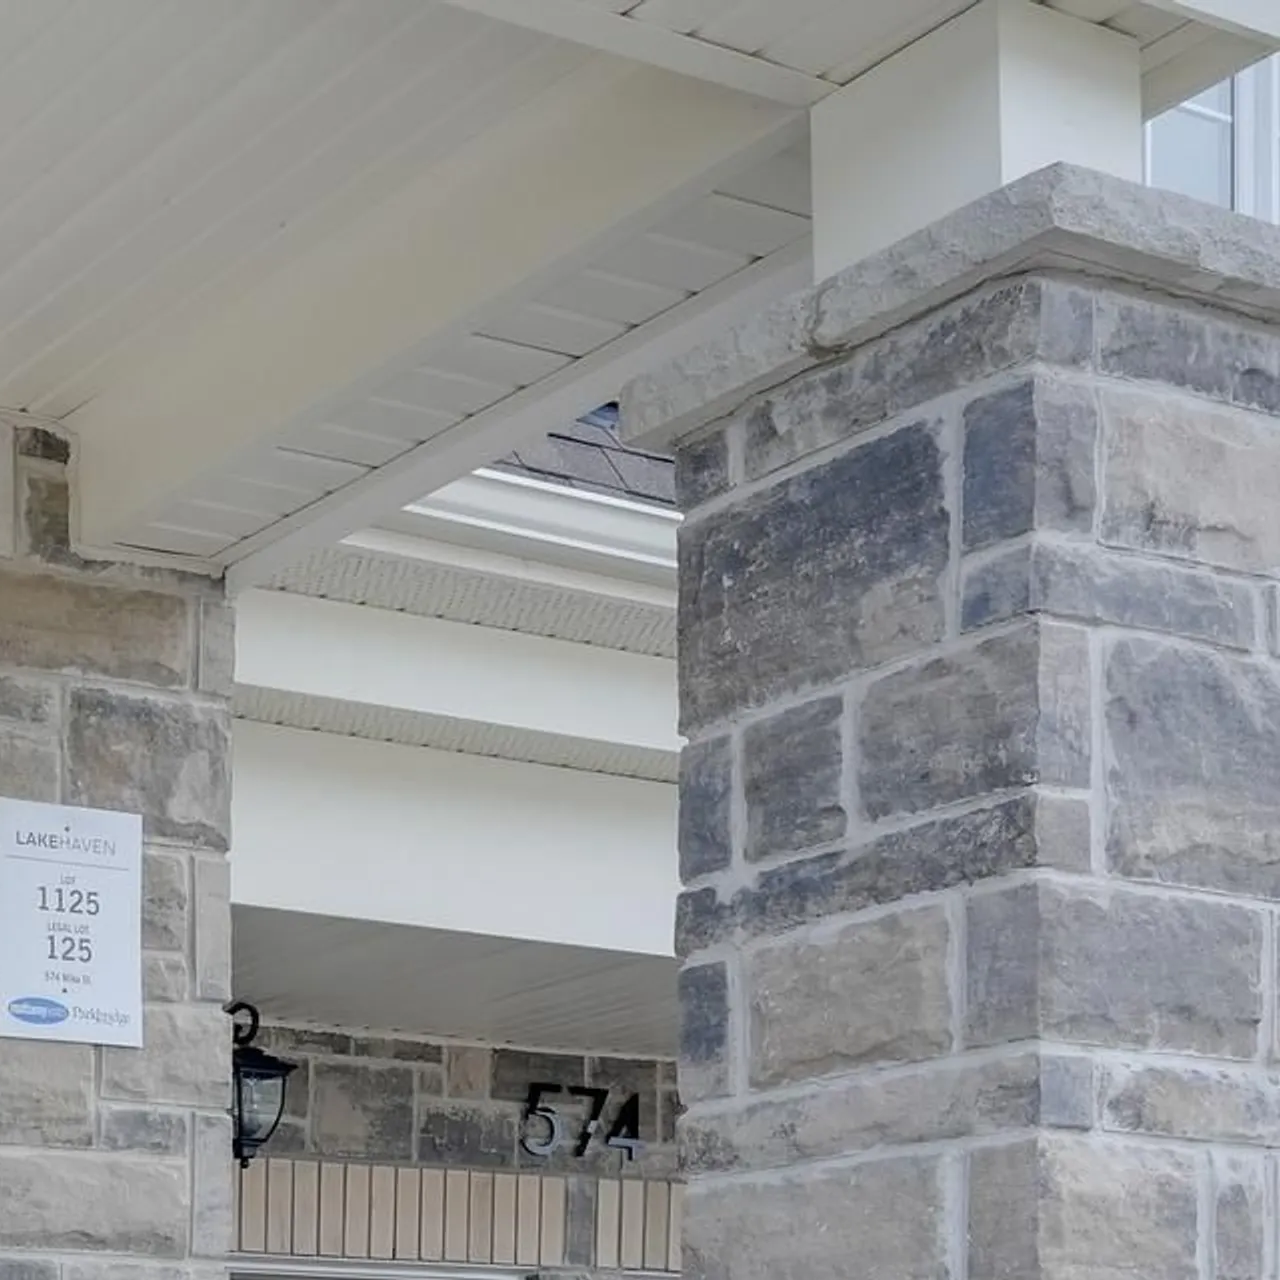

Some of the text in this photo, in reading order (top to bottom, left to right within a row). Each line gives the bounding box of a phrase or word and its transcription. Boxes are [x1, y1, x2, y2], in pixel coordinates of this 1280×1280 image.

[15, 831, 117, 856] LAKEHAVEN
[38, 886, 100, 915] 1125
[47, 935, 92, 963] 125
[519, 1082, 647, 1161] 574
